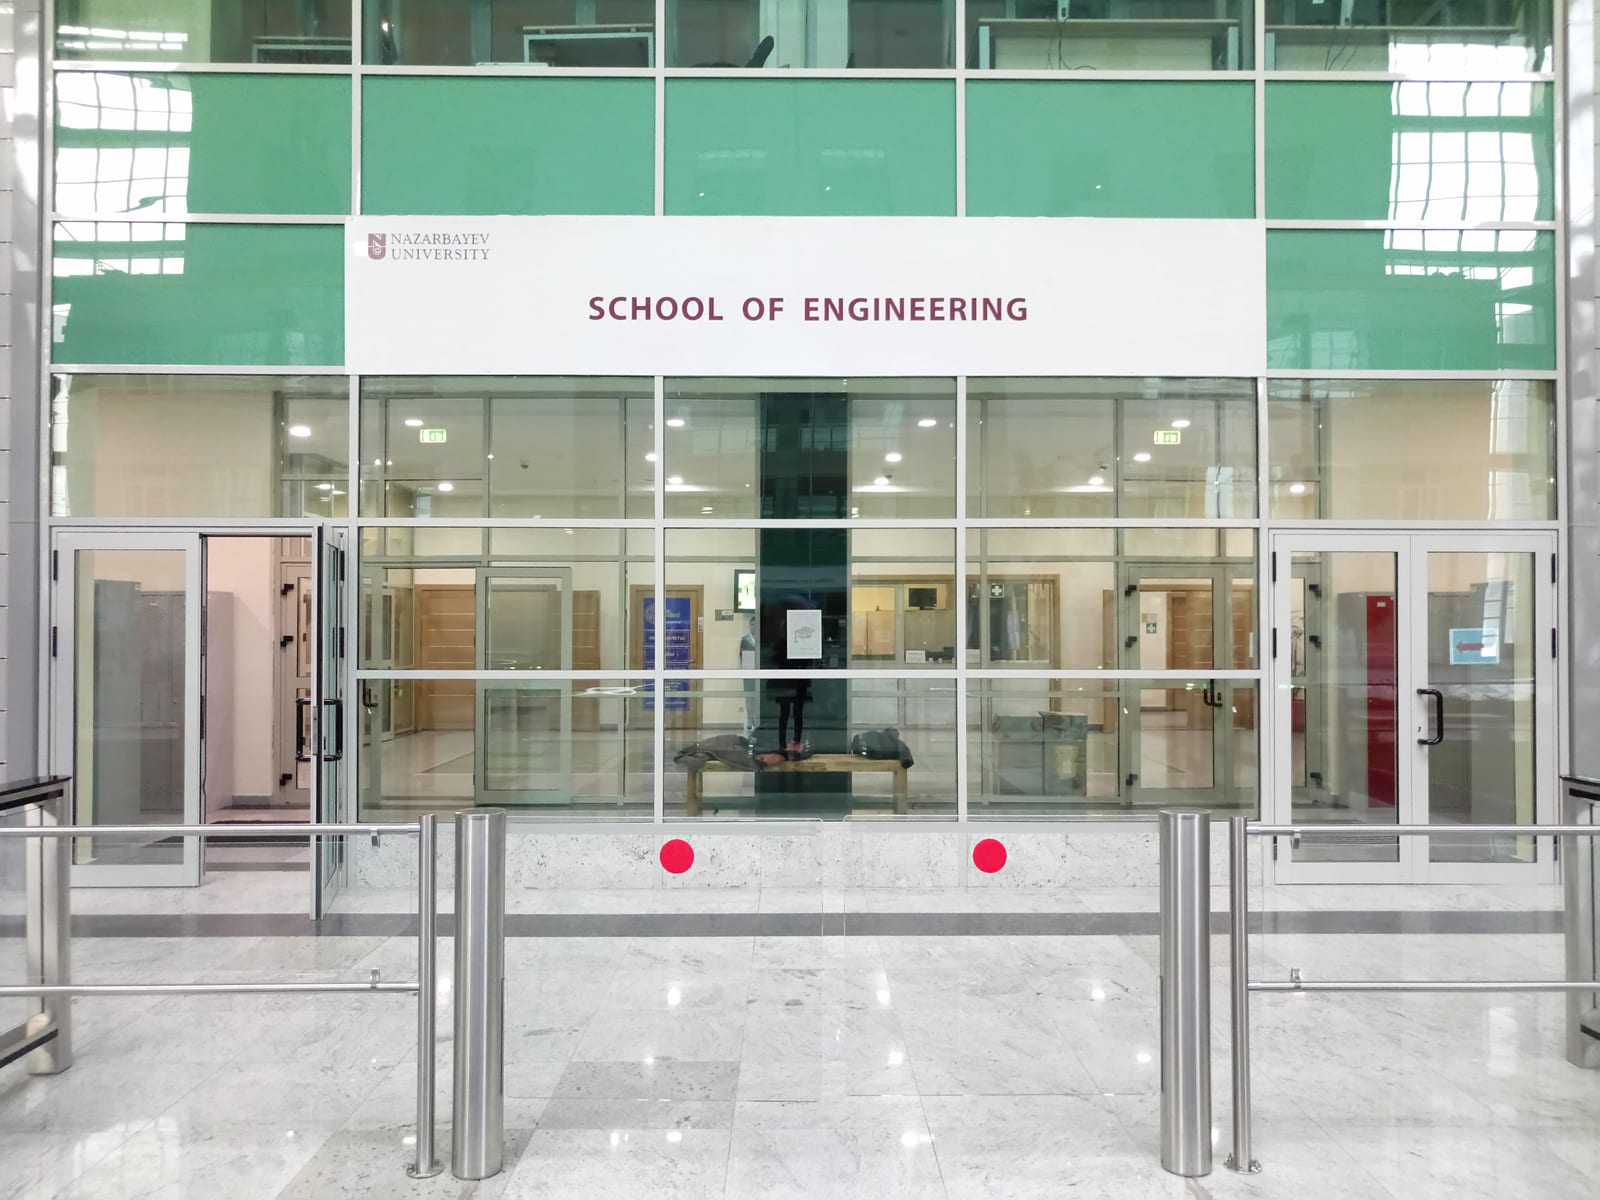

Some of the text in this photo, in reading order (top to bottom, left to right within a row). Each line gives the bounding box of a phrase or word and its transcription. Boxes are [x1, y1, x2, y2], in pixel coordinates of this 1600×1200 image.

[391, 232, 490, 246] NAZARBAYEV
[391, 248, 490, 260] UNIVERSITY
[588, 297, 1028, 322] SCHOOL OF ENGINEERING
